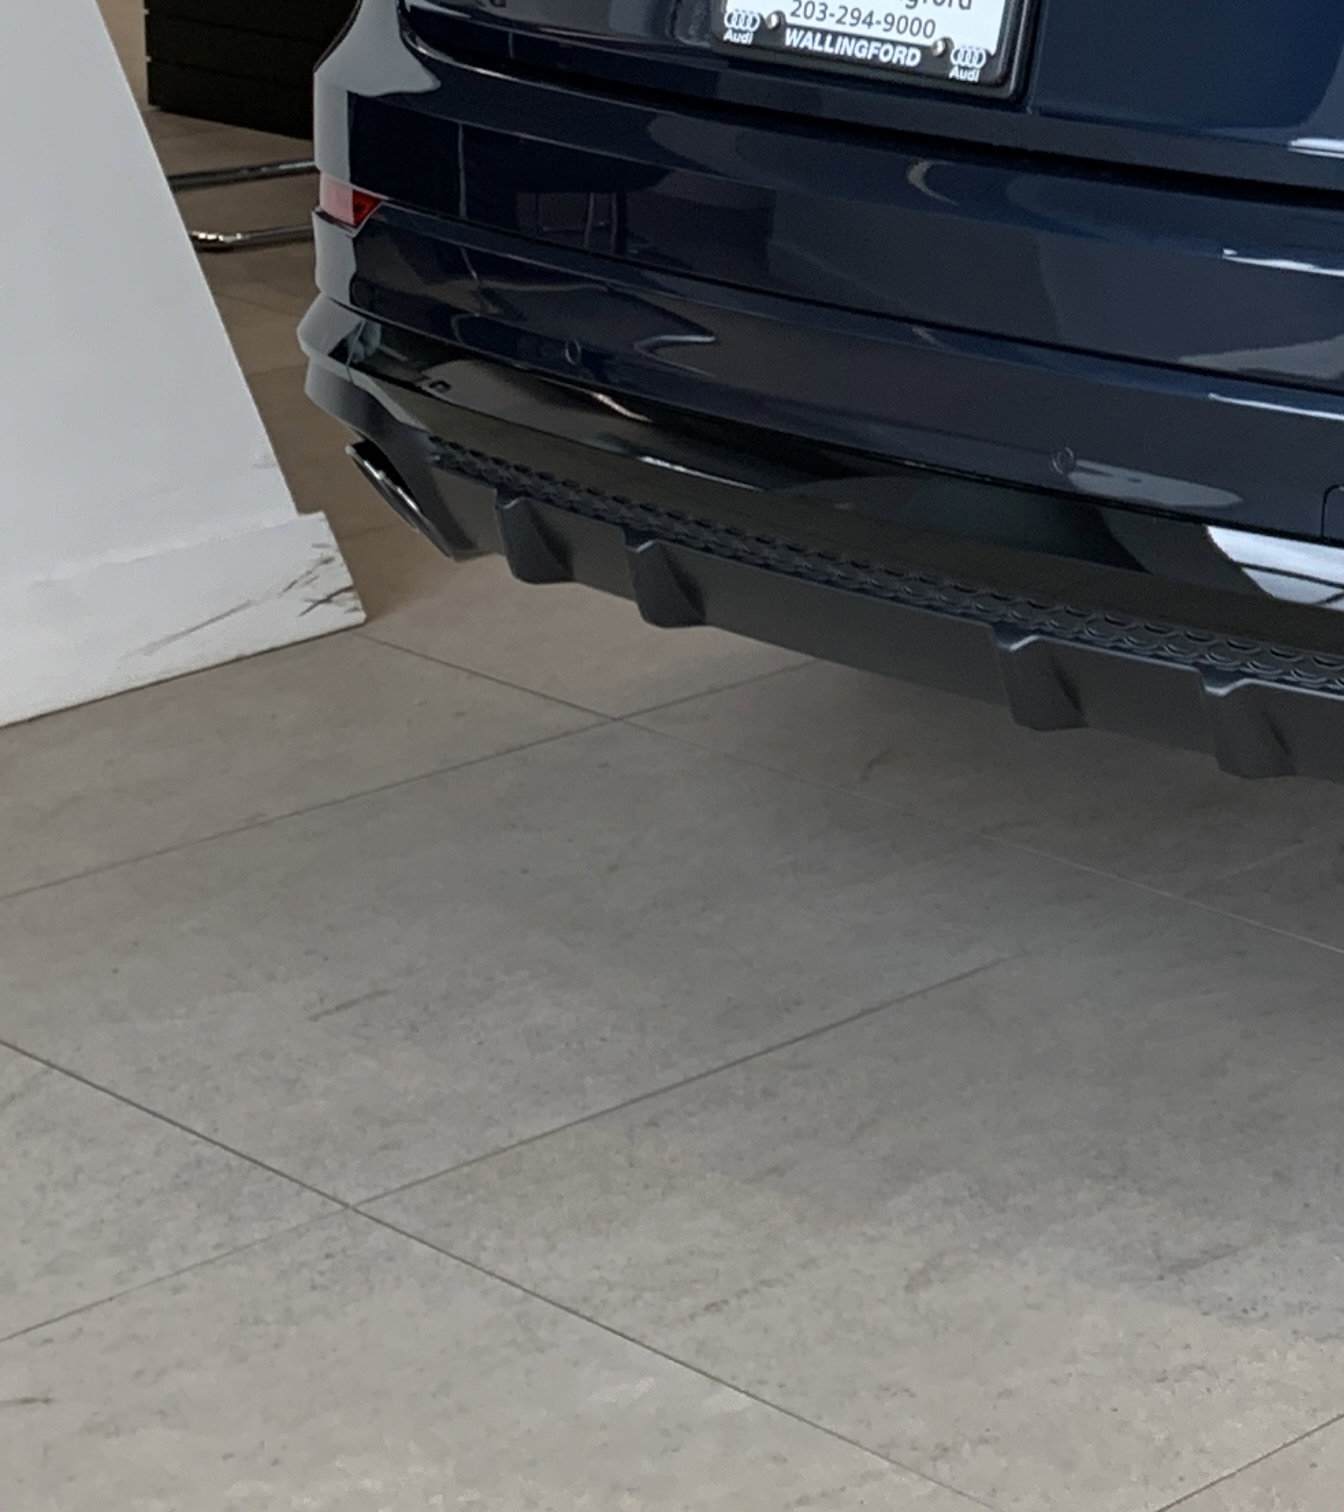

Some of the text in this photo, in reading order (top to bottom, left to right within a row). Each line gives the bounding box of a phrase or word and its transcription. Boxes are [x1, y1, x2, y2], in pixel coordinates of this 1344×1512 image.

[790, 0, 937, 39] 203-294-9000
[723, 30, 754, 45] Audi
[785, 28, 922, 68] WALLINGFORD
[949, 67, 980, 83] Audi
